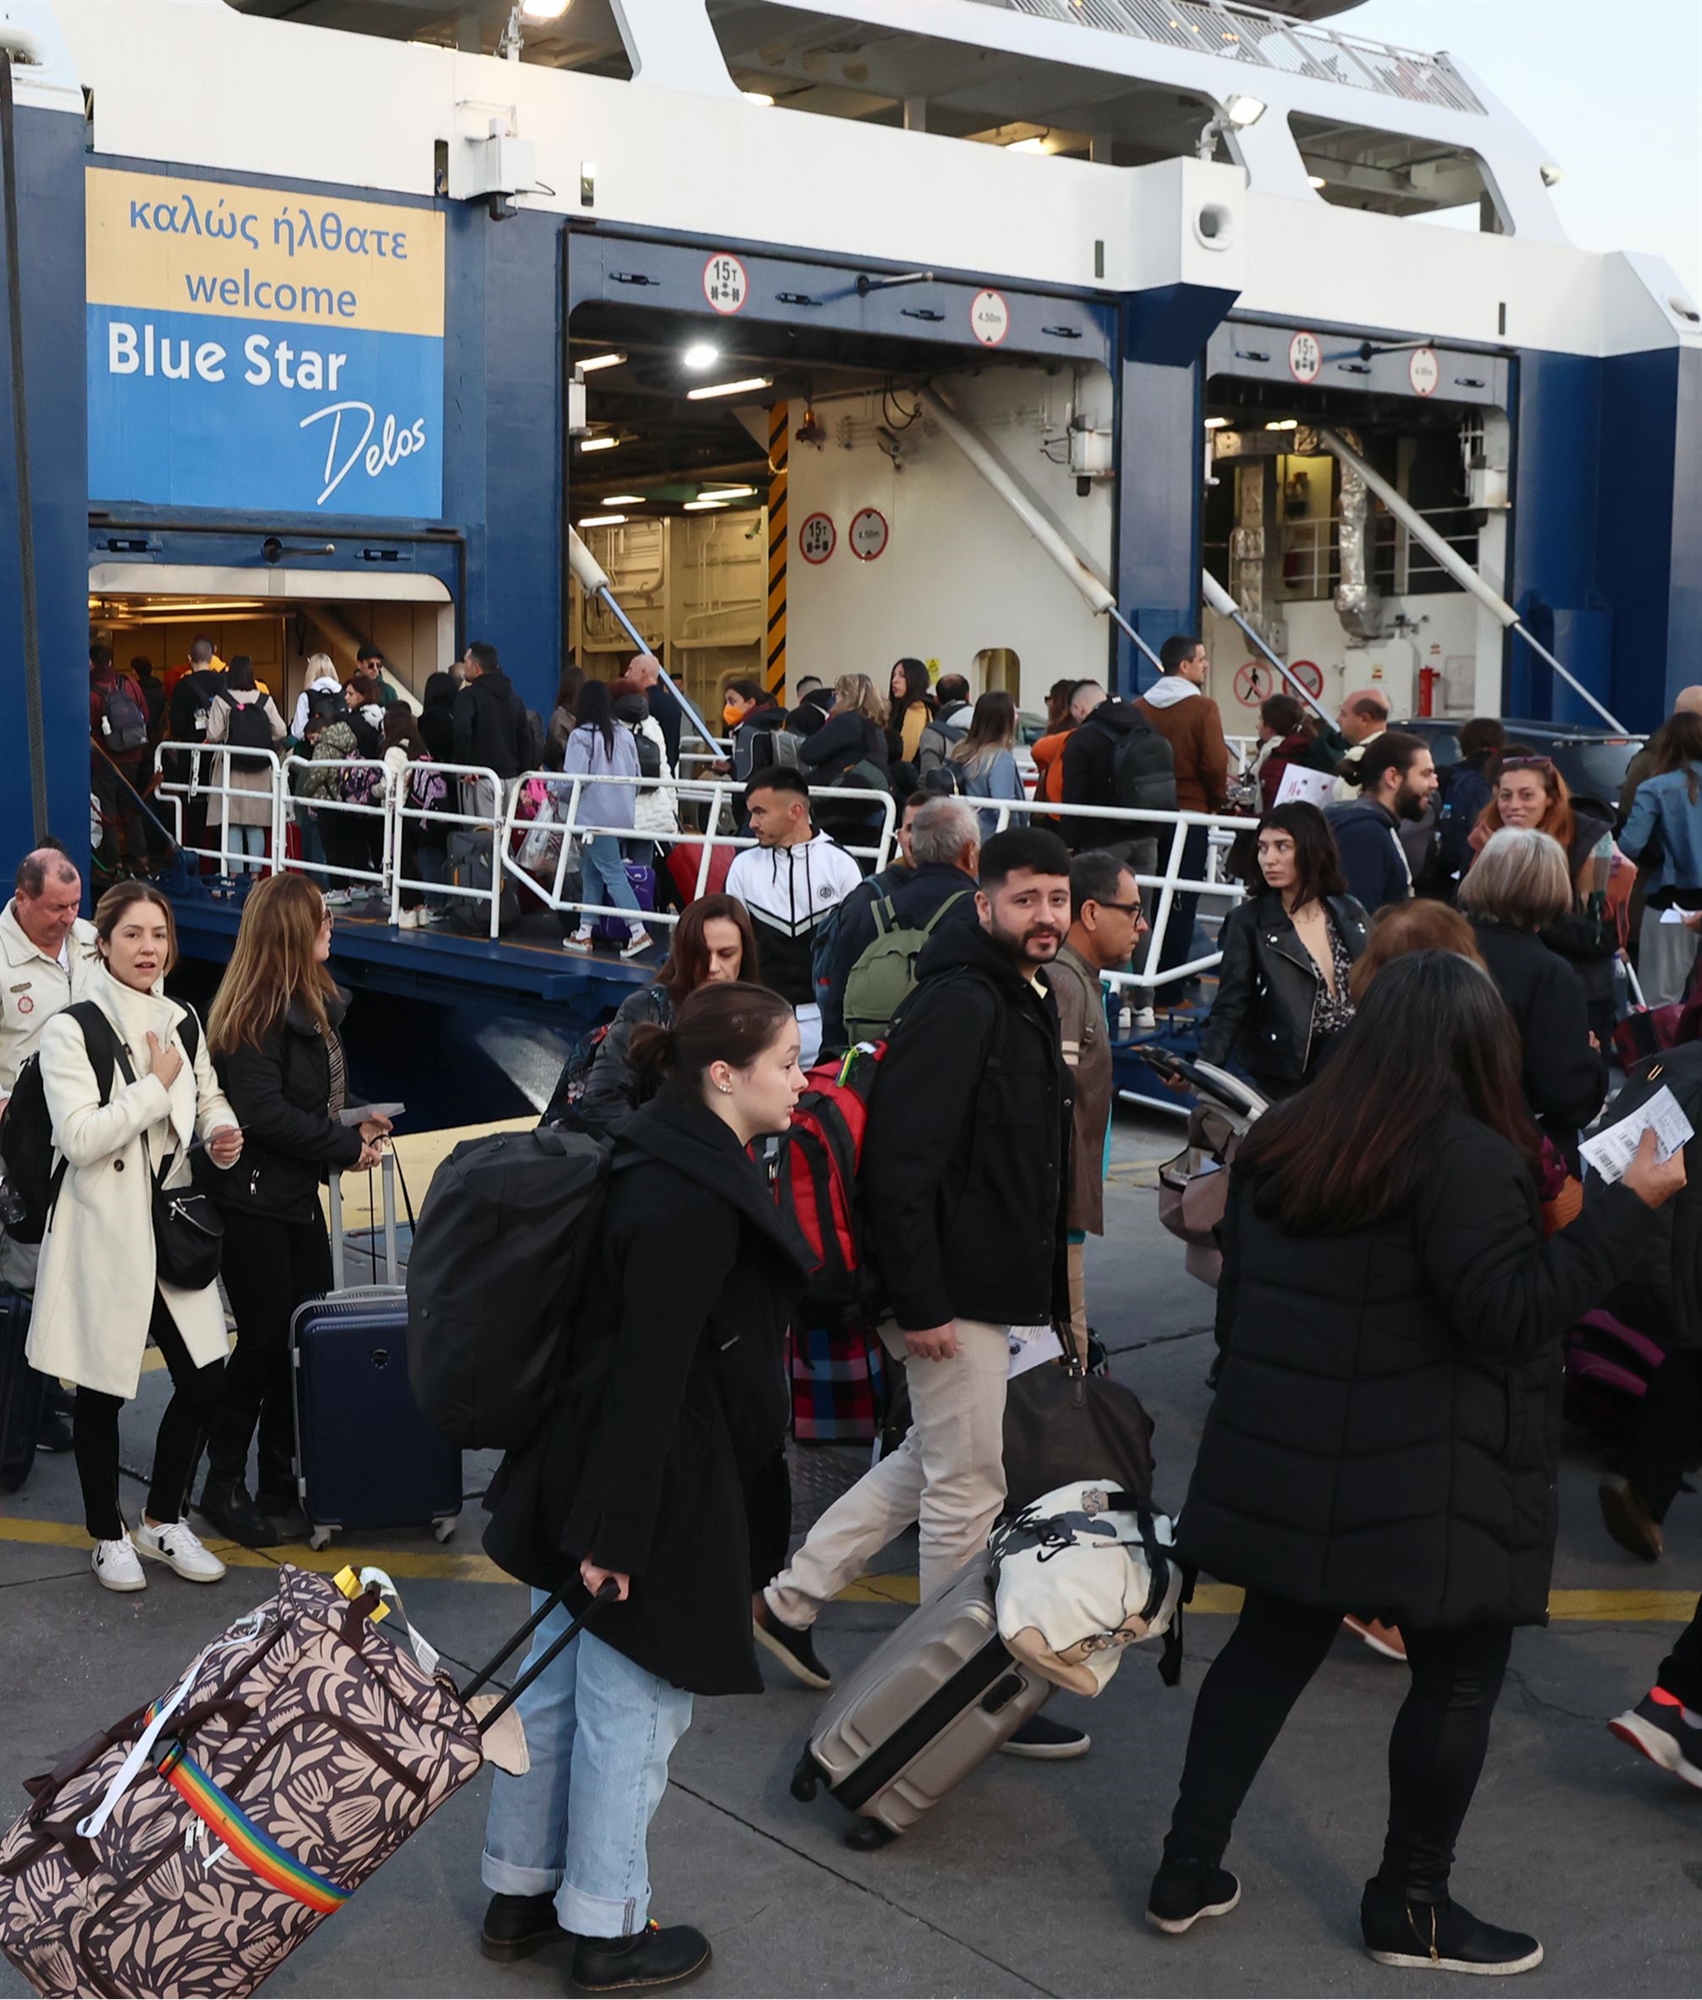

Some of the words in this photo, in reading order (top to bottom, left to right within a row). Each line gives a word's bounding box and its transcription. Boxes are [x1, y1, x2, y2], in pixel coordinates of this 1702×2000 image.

[130, 194, 259, 249] καλώς
[273, 207, 408, 259] ήλθατε
[185, 268, 357, 316] welcome
[978, 312, 1002, 324] 4.50m
[108, 321, 227, 383] Blue
[244, 333, 347, 391] Star
[299, 400, 426, 506] Delos
